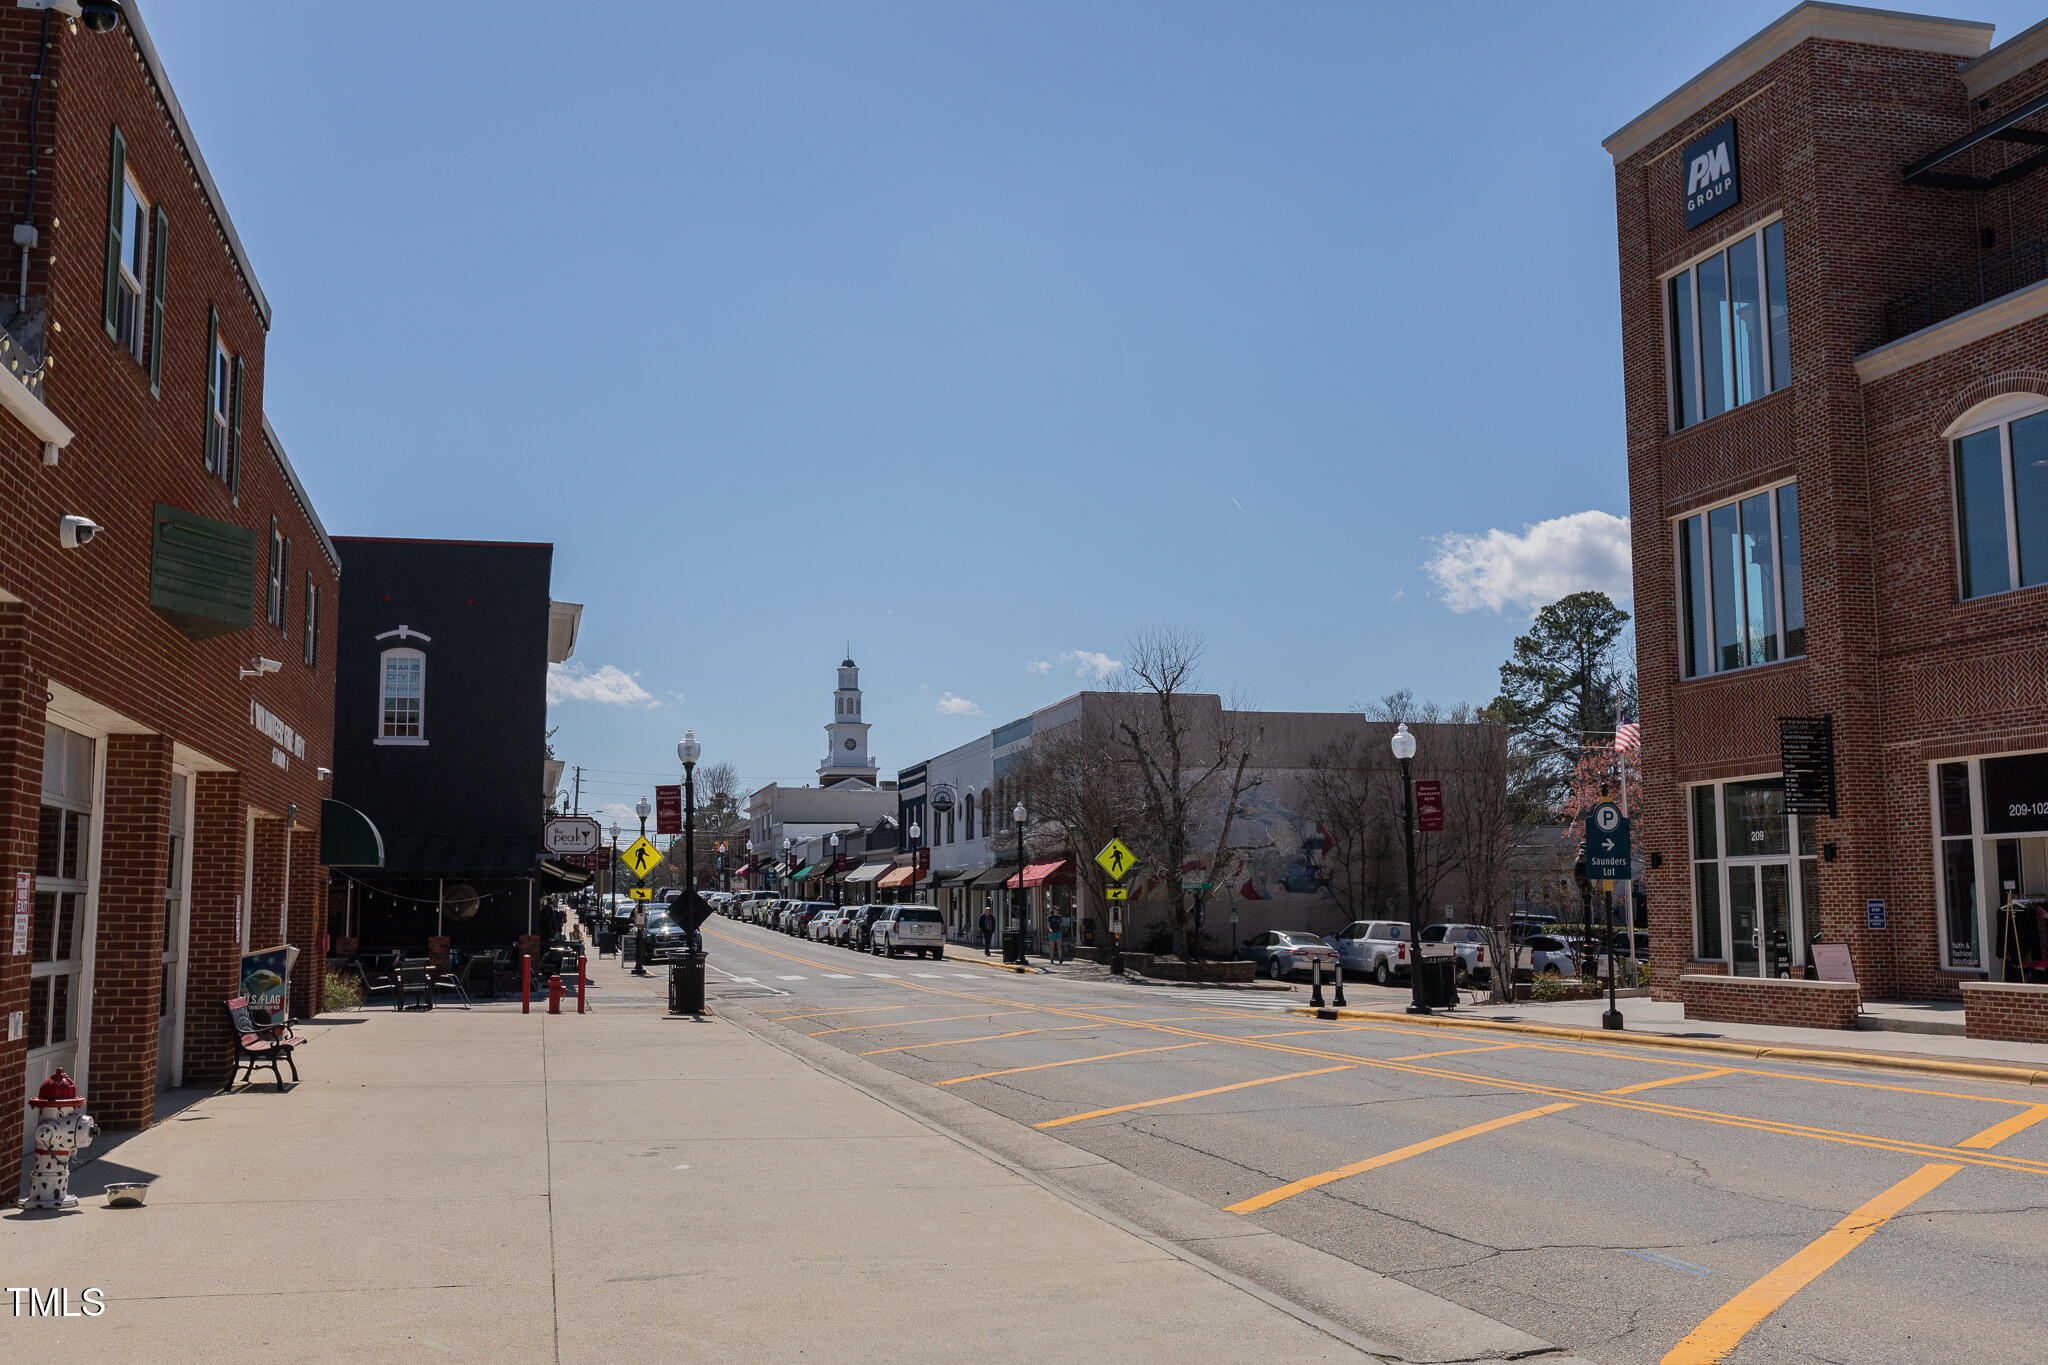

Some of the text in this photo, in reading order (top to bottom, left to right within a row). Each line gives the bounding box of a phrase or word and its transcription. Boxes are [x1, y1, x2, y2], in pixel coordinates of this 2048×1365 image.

[1687, 141, 1731, 197] PM
[1687, 178, 1732, 212] GROUP
[2009, 802, 2048, 816] 209-102
[1603, 811, 1614, 826] P
[553, 827, 582, 846] peak
[1751, 831, 1764, 841] 209
[1591, 857, 1627, 866] Saunders
[1603, 868, 1615, 876] Lot
[1952, 949, 1972, 957] fashion
[261, 994, 281, 1004] FLAG
